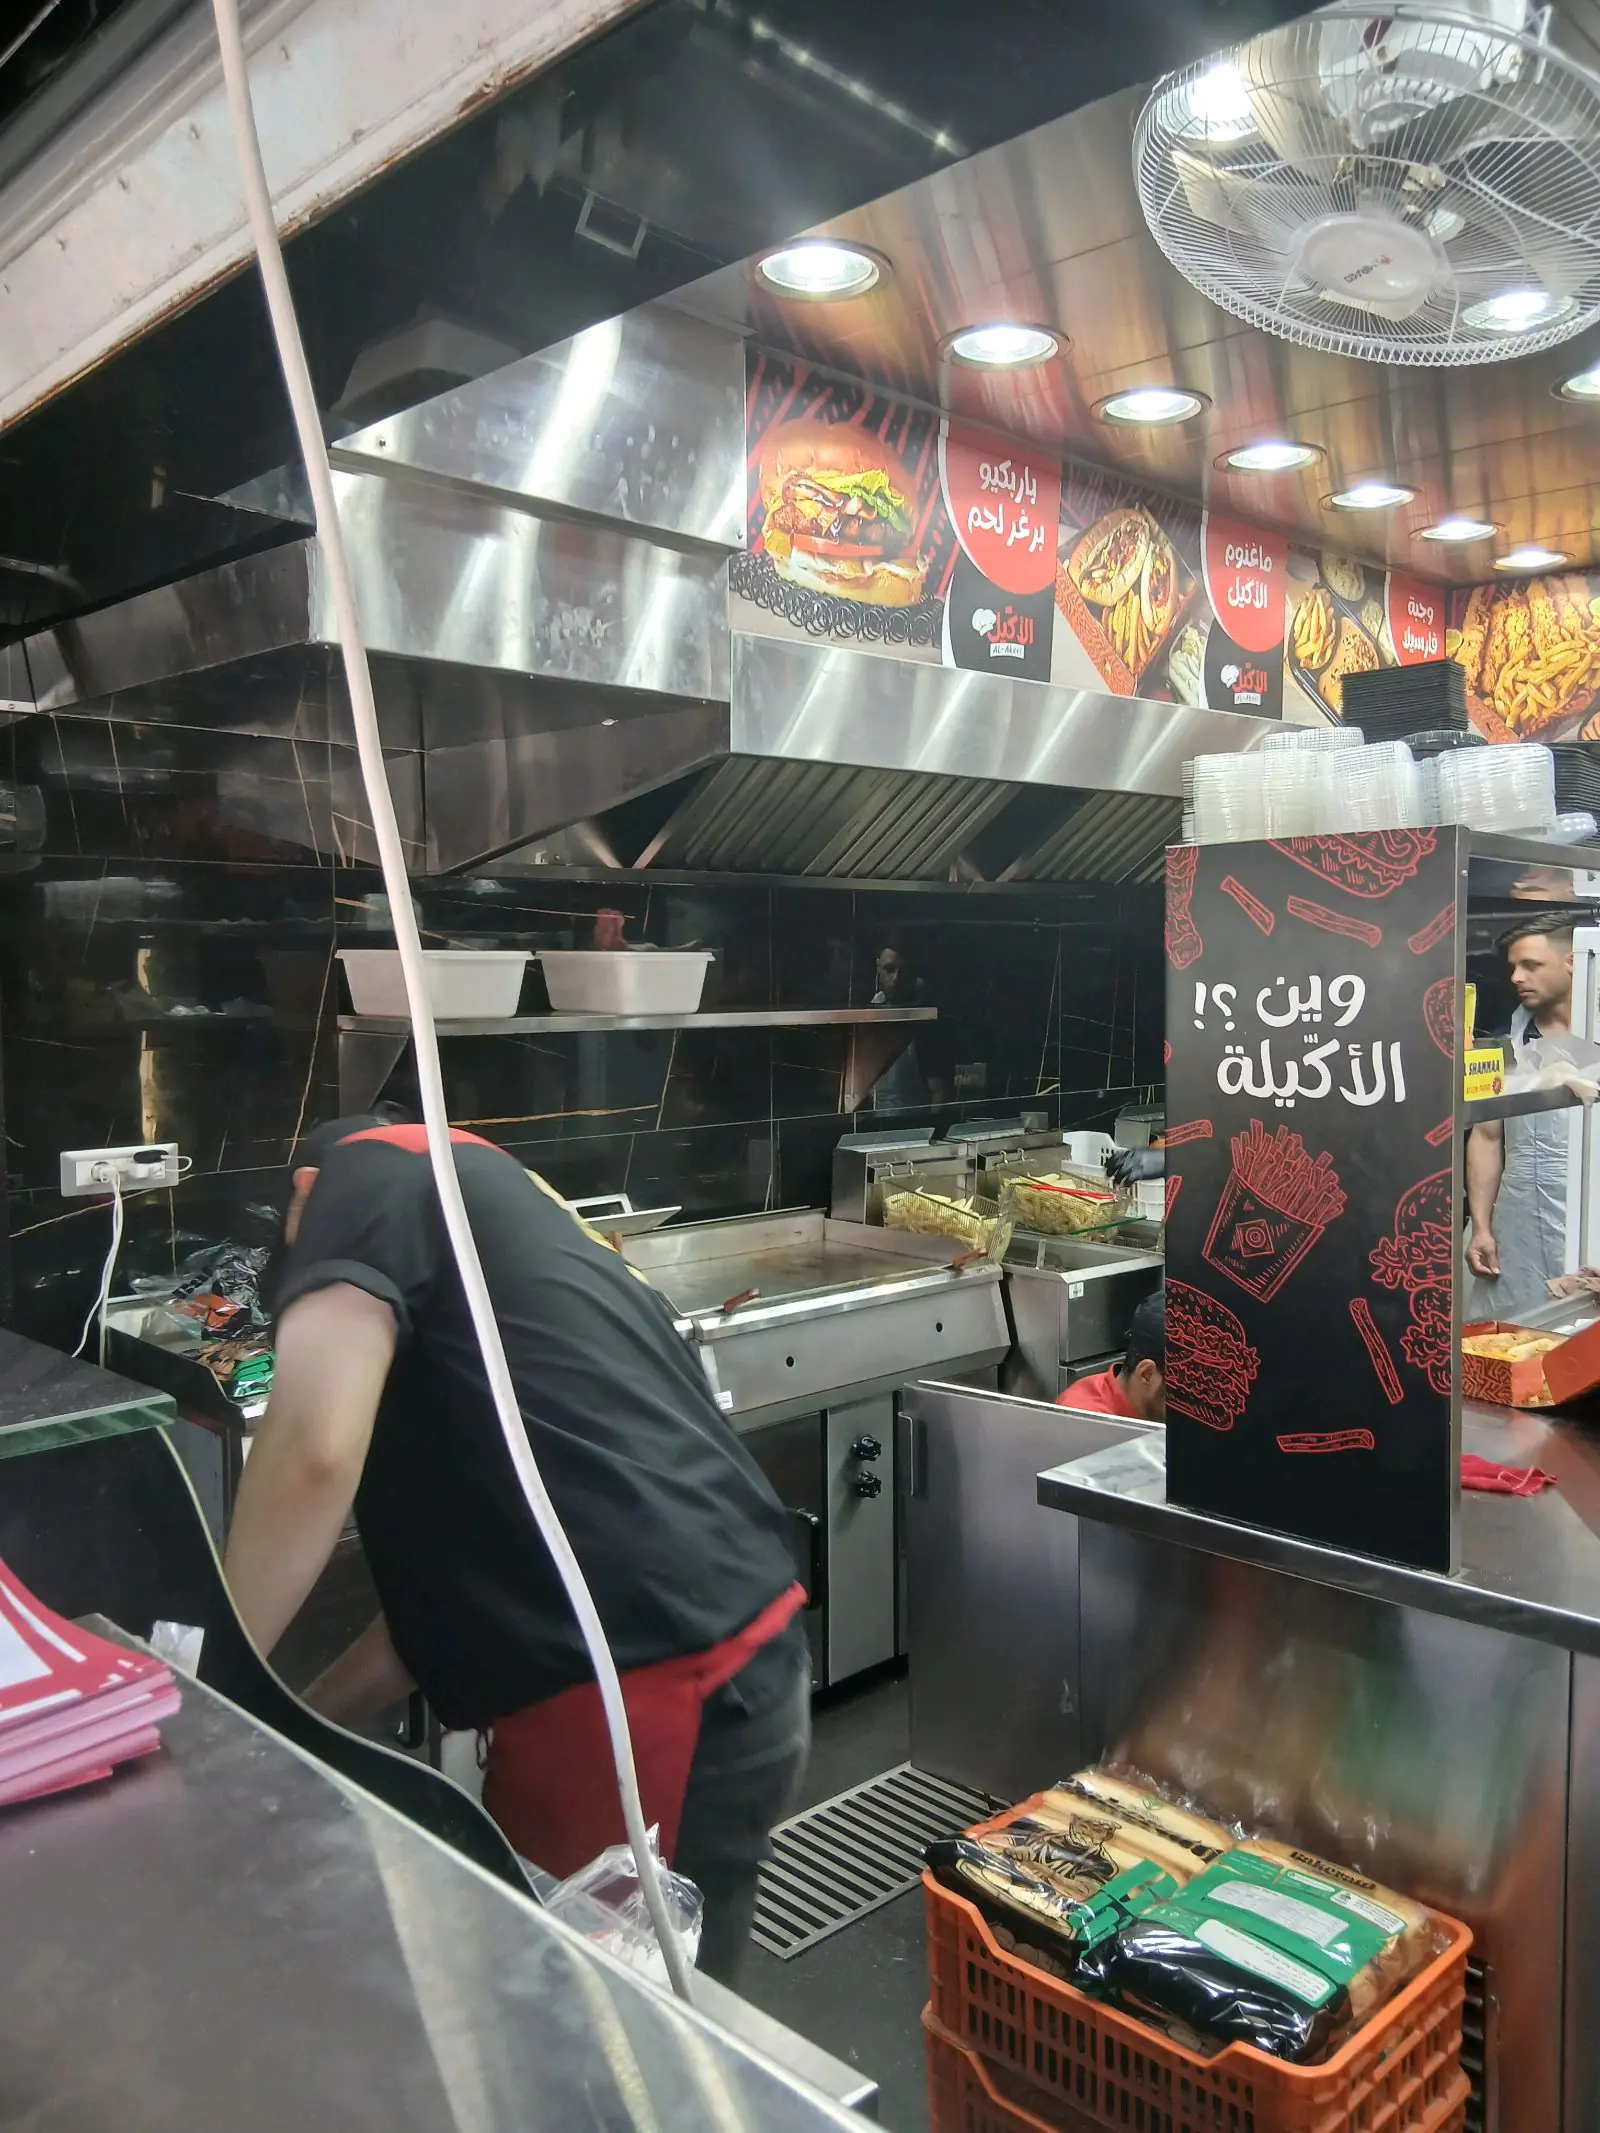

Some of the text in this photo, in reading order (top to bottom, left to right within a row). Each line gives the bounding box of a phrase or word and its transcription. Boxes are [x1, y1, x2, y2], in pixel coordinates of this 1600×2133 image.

[979, 460, 1037, 505] باربكيو
[968, 503, 1045, 553] برغر لحم
[1225, 542, 1272, 572] ماغنوم
[1407, 596, 1434, 626] وجبة
[1256, 974, 1366, 1028] وين
